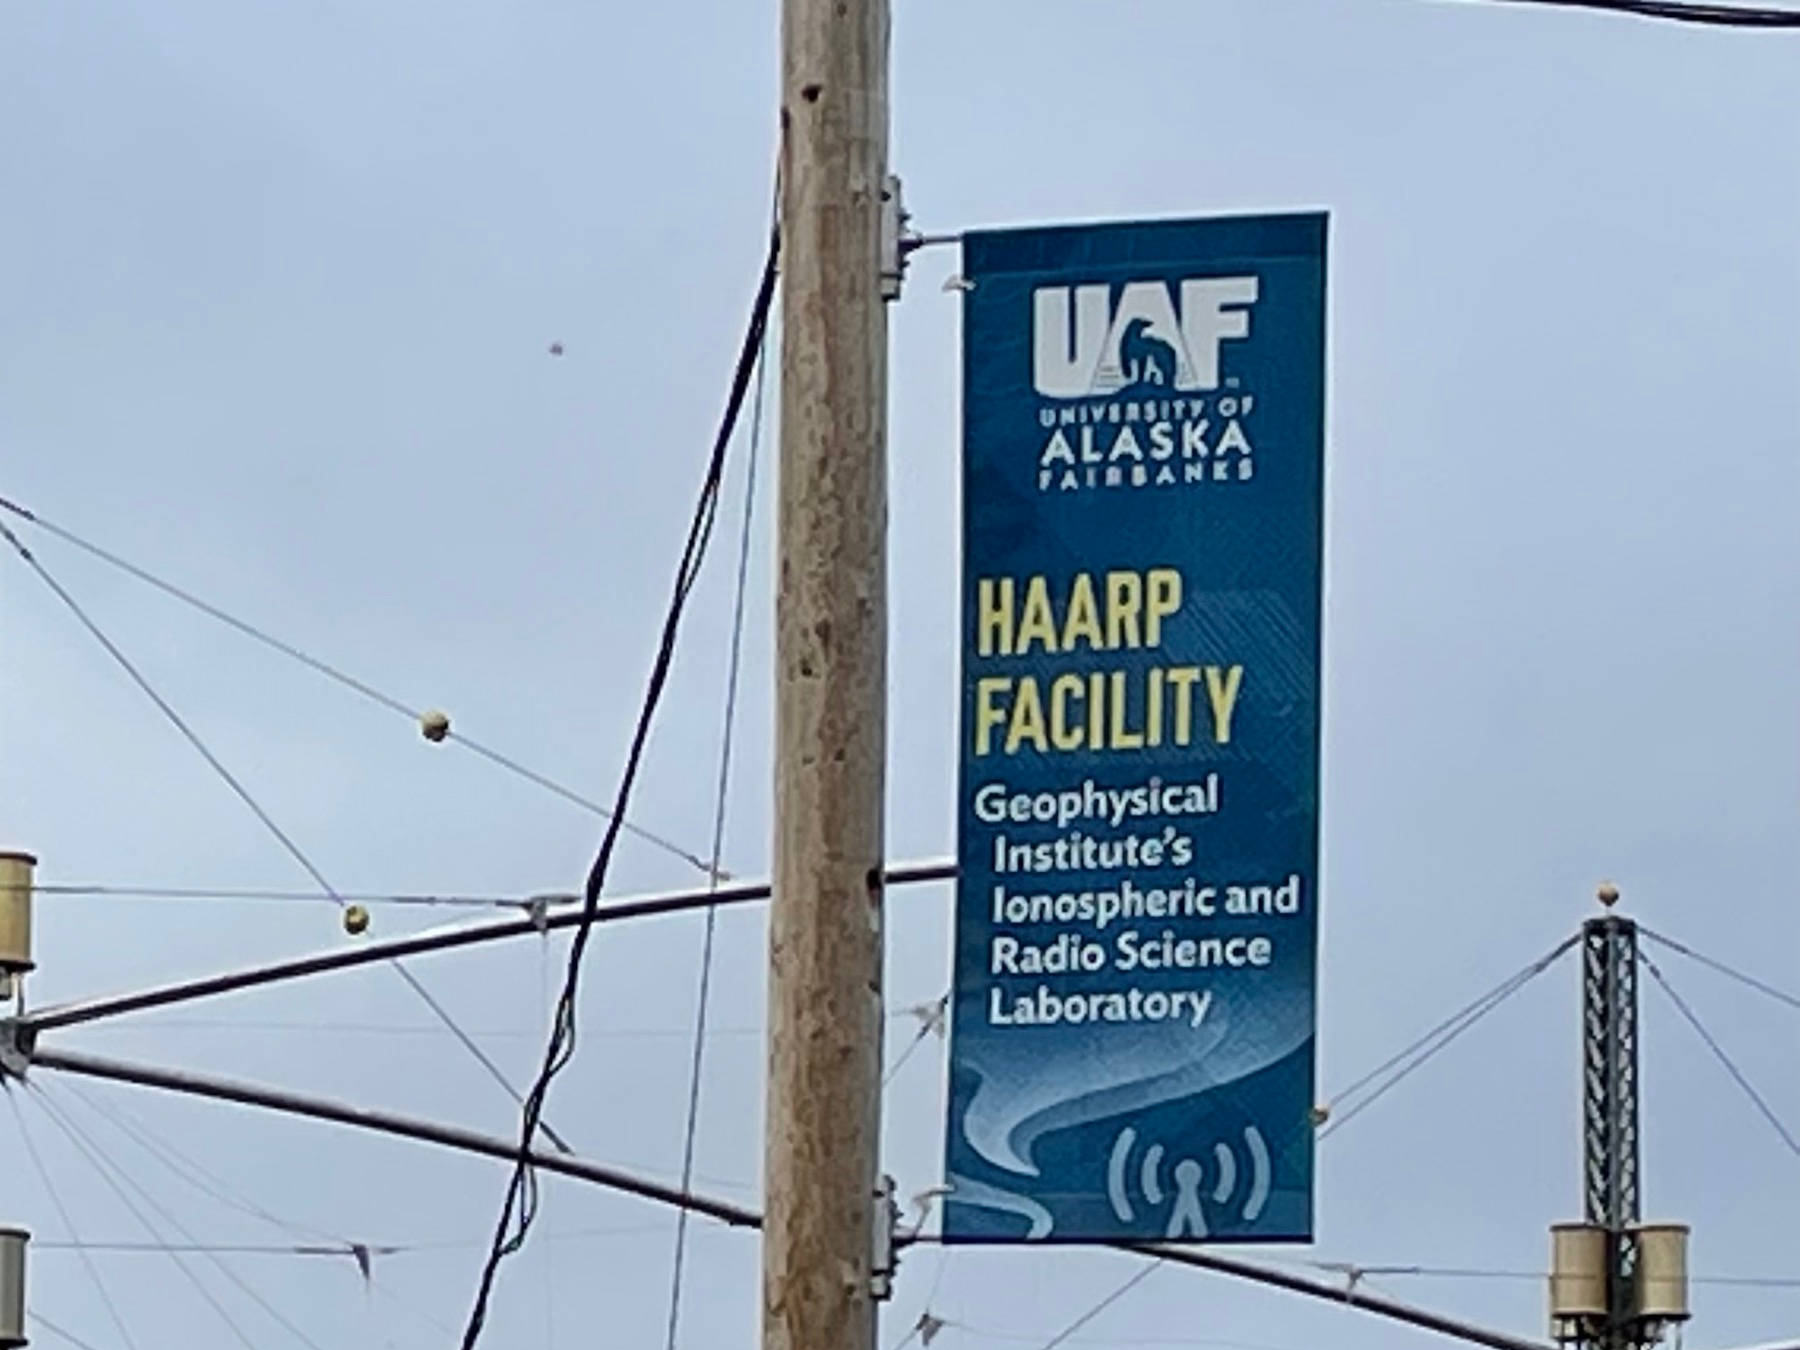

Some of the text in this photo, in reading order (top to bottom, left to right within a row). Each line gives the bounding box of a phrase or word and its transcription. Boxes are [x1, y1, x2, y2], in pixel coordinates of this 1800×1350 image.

[1033, 276, 1259, 398] UAF
[1040, 396, 1253, 426] UNIVERSITY OF
[1040, 420, 1252, 466] ALASKA
[1039, 459, 1253, 491] FAIRBANKS
[978, 568, 1182, 656] HAARP
[975, 665, 1243, 756] FACILITY
[975, 773, 1219, 828] Geophysical
[992, 875, 1299, 929] Ionospheric and
[992, 931, 1272, 974] Radio Science
[989, 986, 1211, 1028] Laboratory
